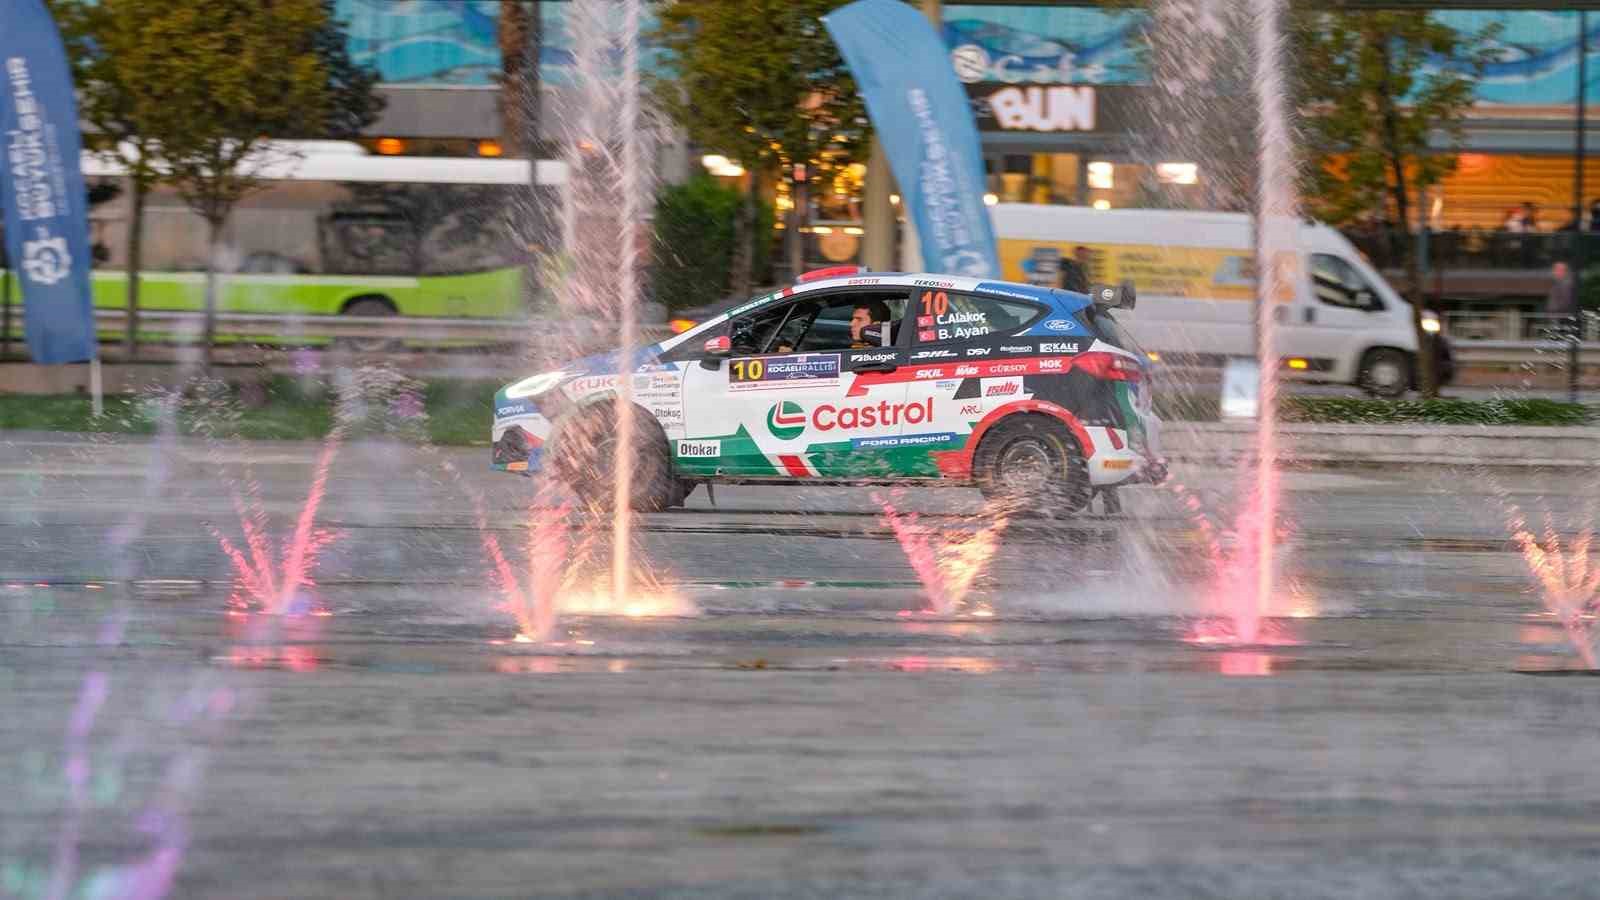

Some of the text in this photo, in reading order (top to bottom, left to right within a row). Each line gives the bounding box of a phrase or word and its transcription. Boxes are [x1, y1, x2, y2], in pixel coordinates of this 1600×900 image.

[988, 85, 1097, 131] BUN
[921, 291, 949, 317] 10
[936, 312, 986, 326] C.Alakoç
[938, 326, 990, 341] B. Ayan
[863, 352, 897, 362] Budget
[912, 350, 957, 358] DHL
[966, 348, 992, 356] DSV
[733, 360, 763, 380] 10
[915, 369, 944, 379] SKIL
[812, 396, 934, 432] Castrol
[860, 434, 951, 446] FORD RACING
[680, 443, 718, 457] Otokar
